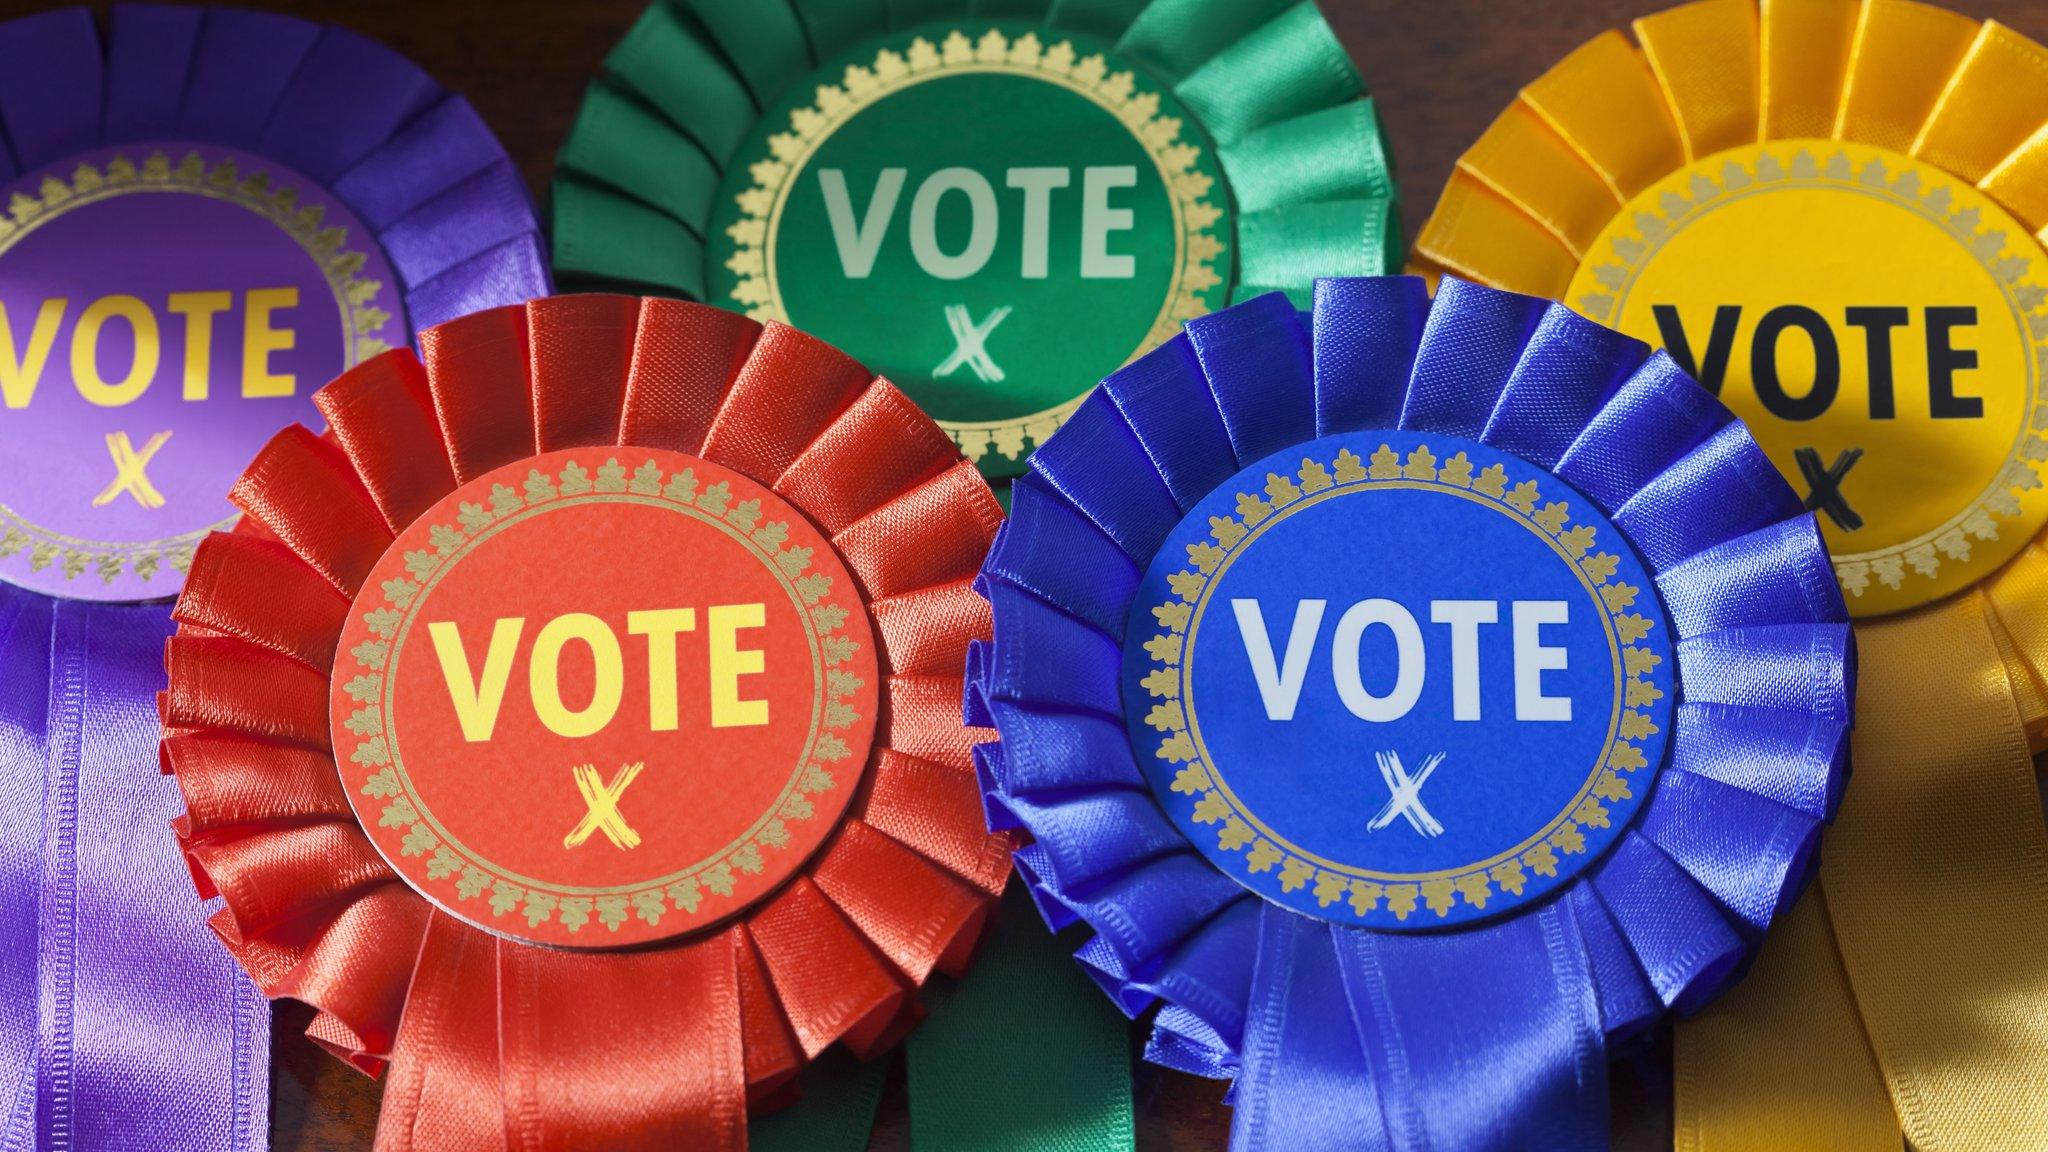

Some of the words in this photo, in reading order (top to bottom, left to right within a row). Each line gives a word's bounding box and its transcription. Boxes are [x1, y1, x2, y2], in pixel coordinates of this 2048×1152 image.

[818, 166, 1137, 280] VOTE
[0, 288, 299, 409] VOTE
[933, 305, 1012, 382] X
[1651, 305, 1984, 422] VOTE
[92, 430, 173, 510] X
[1794, 447, 1864, 532] X
[428, 603, 769, 742] VOTE
[1231, 598, 1572, 722] VOTE
[563, 762, 644, 851] X
[1367, 749, 1446, 838] X
